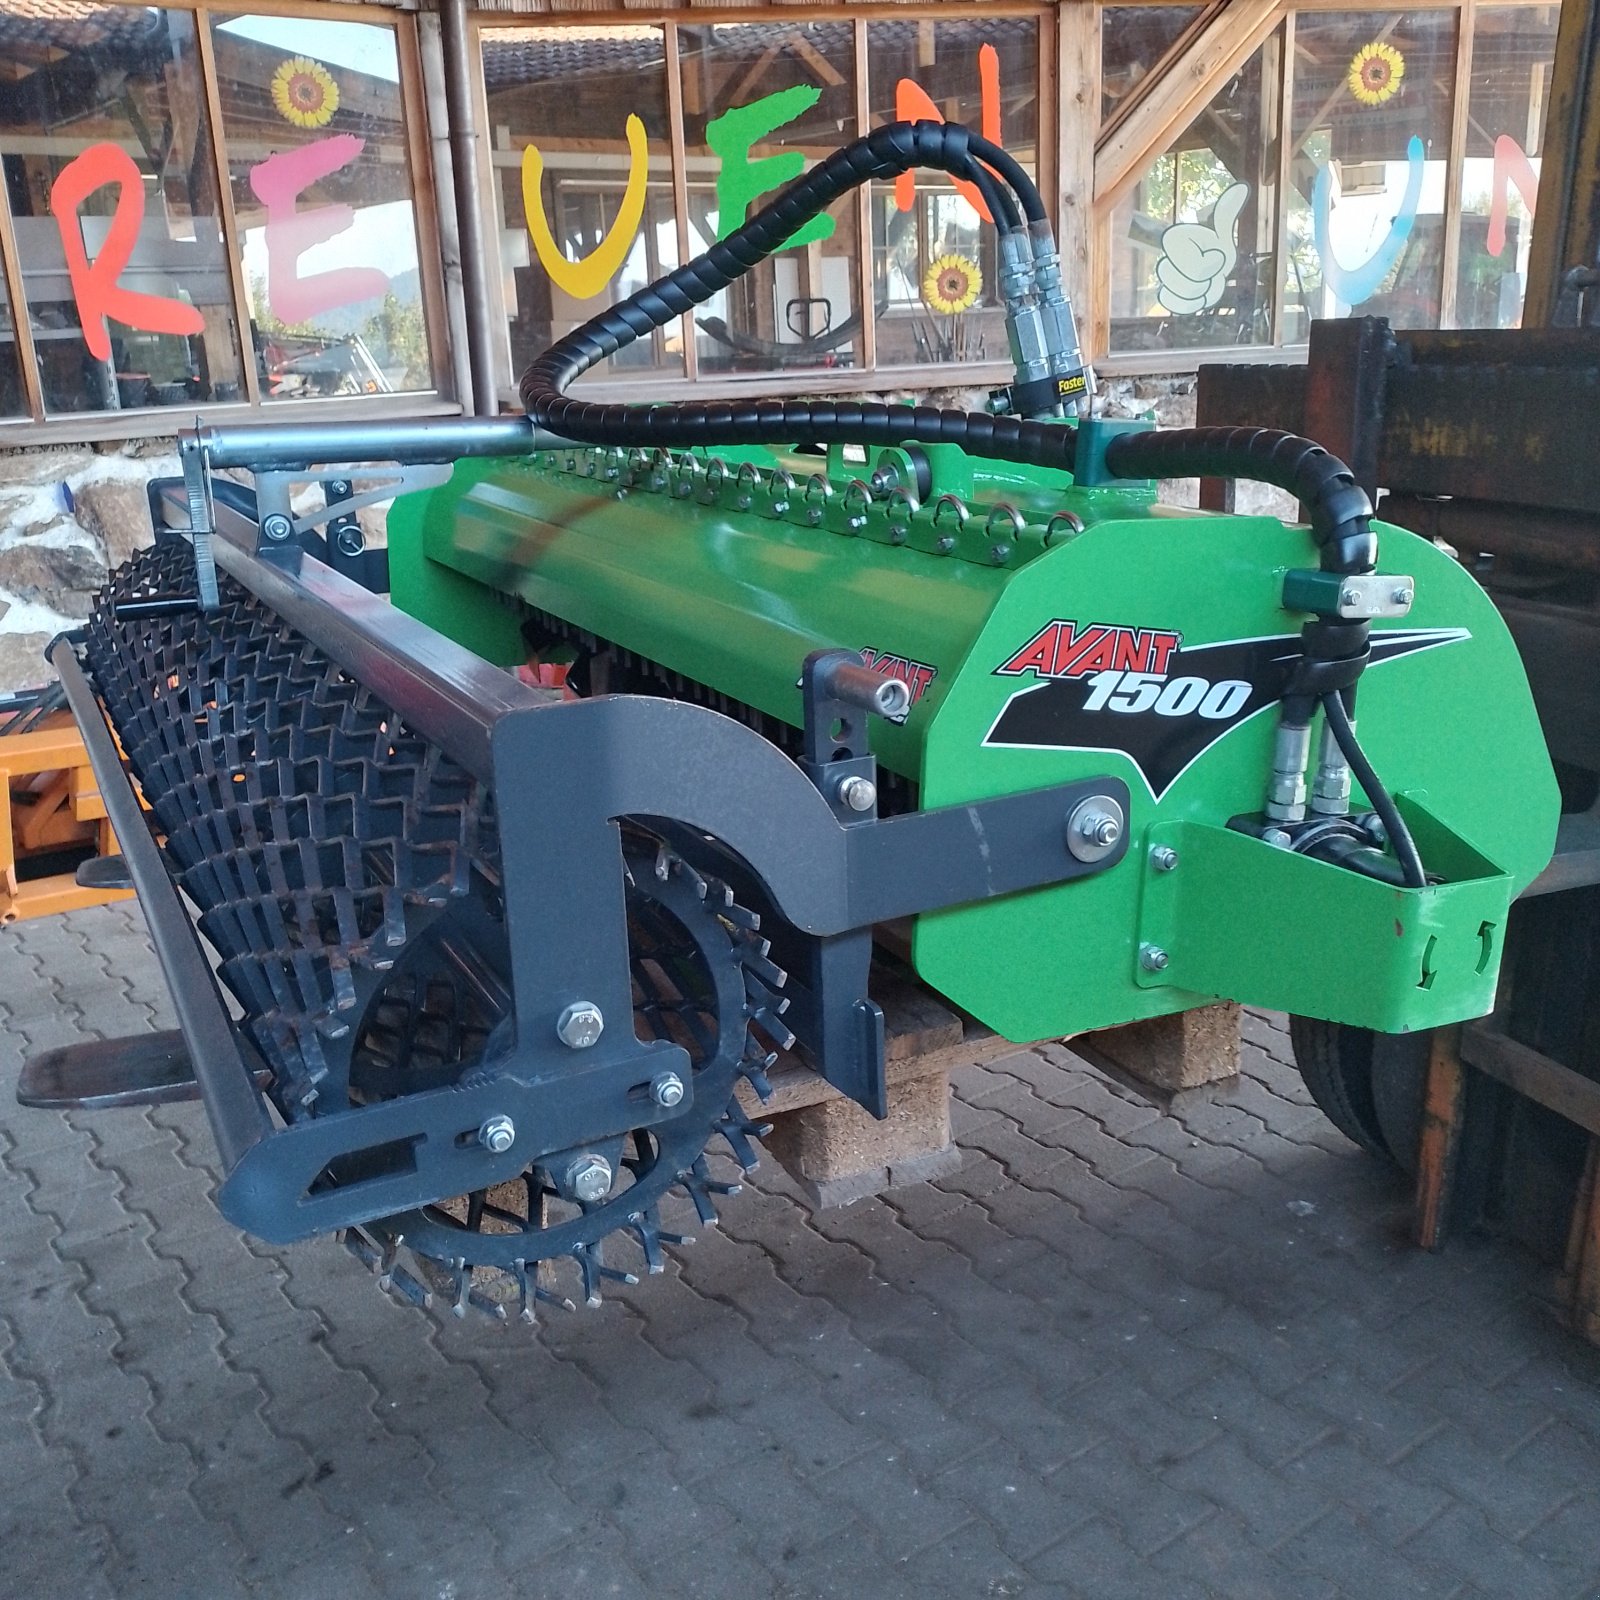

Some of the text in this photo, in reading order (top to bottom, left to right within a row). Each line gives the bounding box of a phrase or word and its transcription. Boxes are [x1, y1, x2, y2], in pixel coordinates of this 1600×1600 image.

[1058, 376, 1086, 392] Faster
[991, 618, 1181, 680] AVANT
[1082, 670, 1253, 719] 1500
